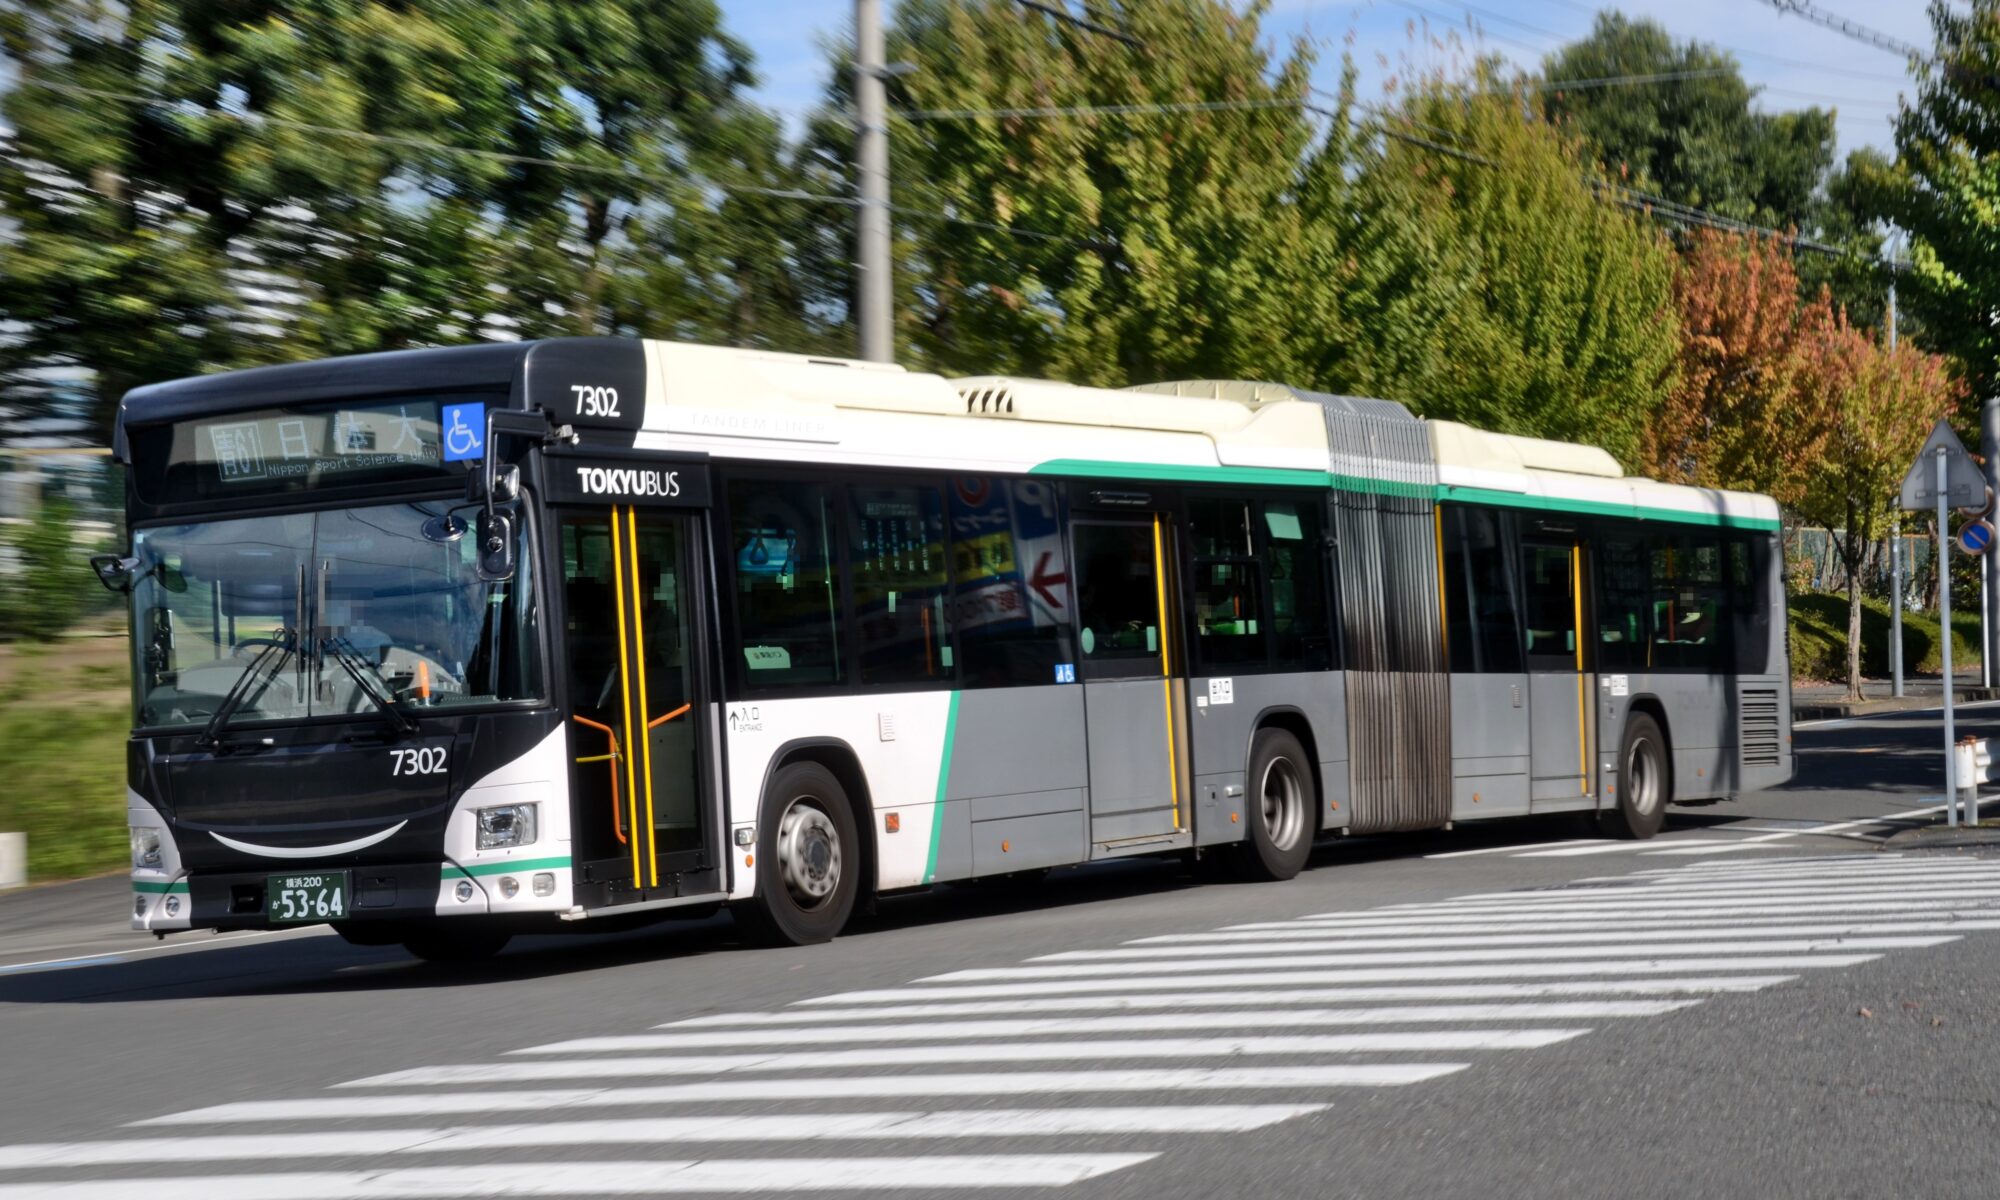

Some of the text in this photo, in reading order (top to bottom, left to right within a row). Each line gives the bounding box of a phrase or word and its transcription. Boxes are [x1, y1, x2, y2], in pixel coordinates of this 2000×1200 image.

[570, 385, 621, 418] 7302
[692, 412, 825, 433] TANDEM LINER
[268, 463, 309, 476] Nippon
[314, 457, 350, 472] Sport
[355, 454, 403, 467] Science
[741, 707, 760, 721] 入口
[390, 747, 448, 776] 7302
[286, 876, 322, 888] 横浜200
[281, 887, 343, 918] 53-64
